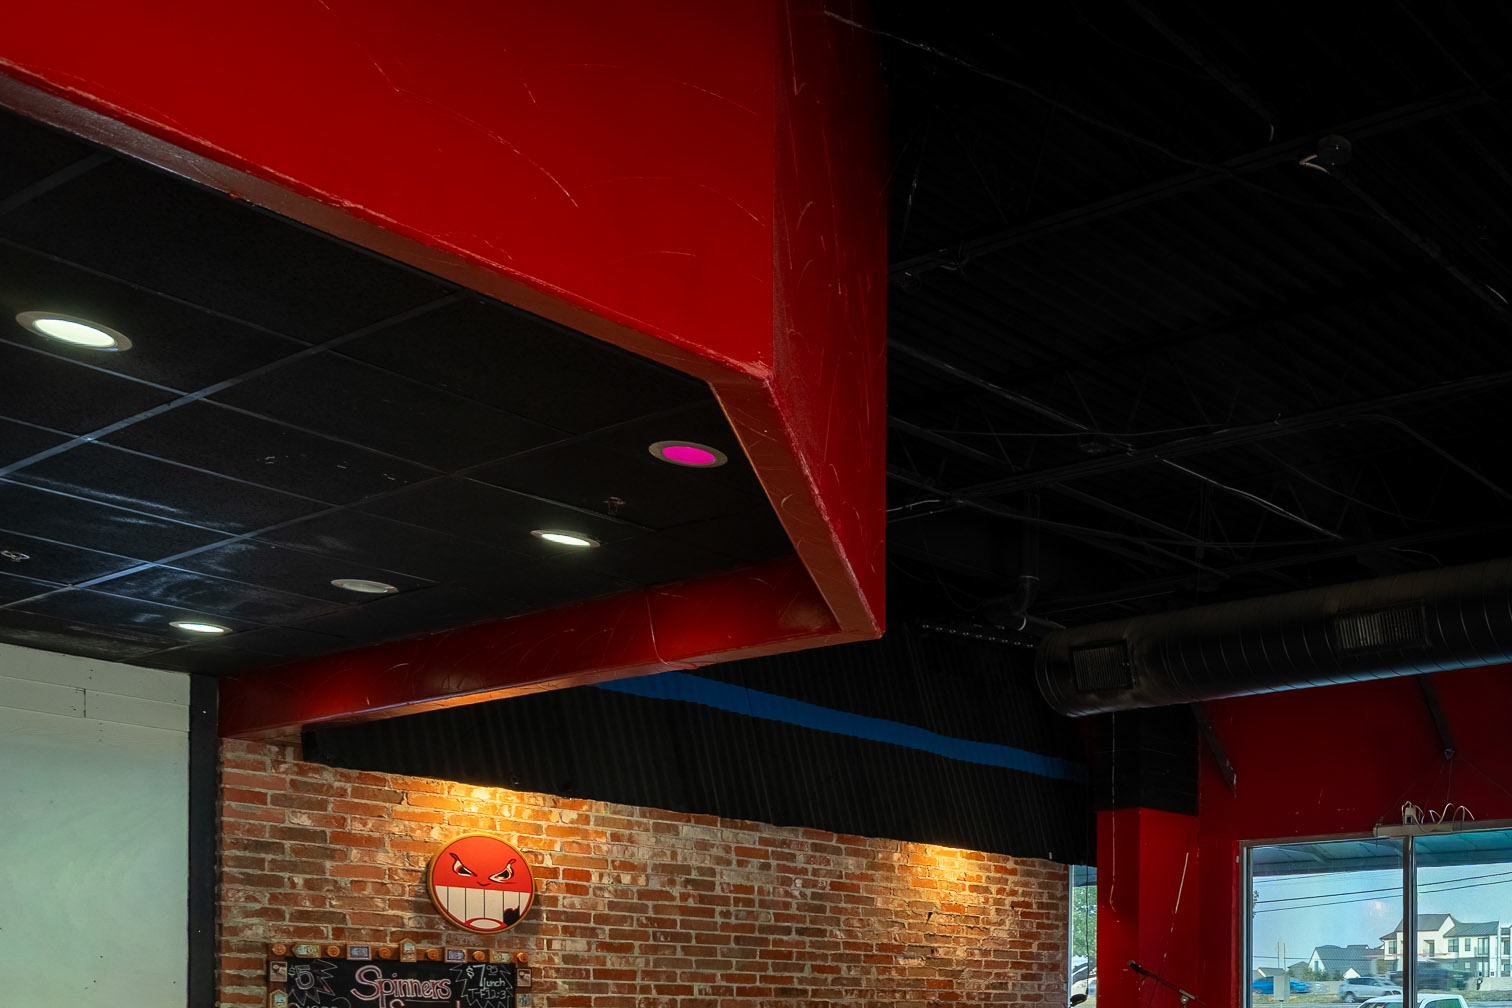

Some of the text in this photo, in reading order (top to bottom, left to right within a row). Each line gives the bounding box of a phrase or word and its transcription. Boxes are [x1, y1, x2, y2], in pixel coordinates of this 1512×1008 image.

[288, 965, 315, 989] $5
[350, 965, 451, 1008] Spinners
[483, 977, 505, 990] Lunch
